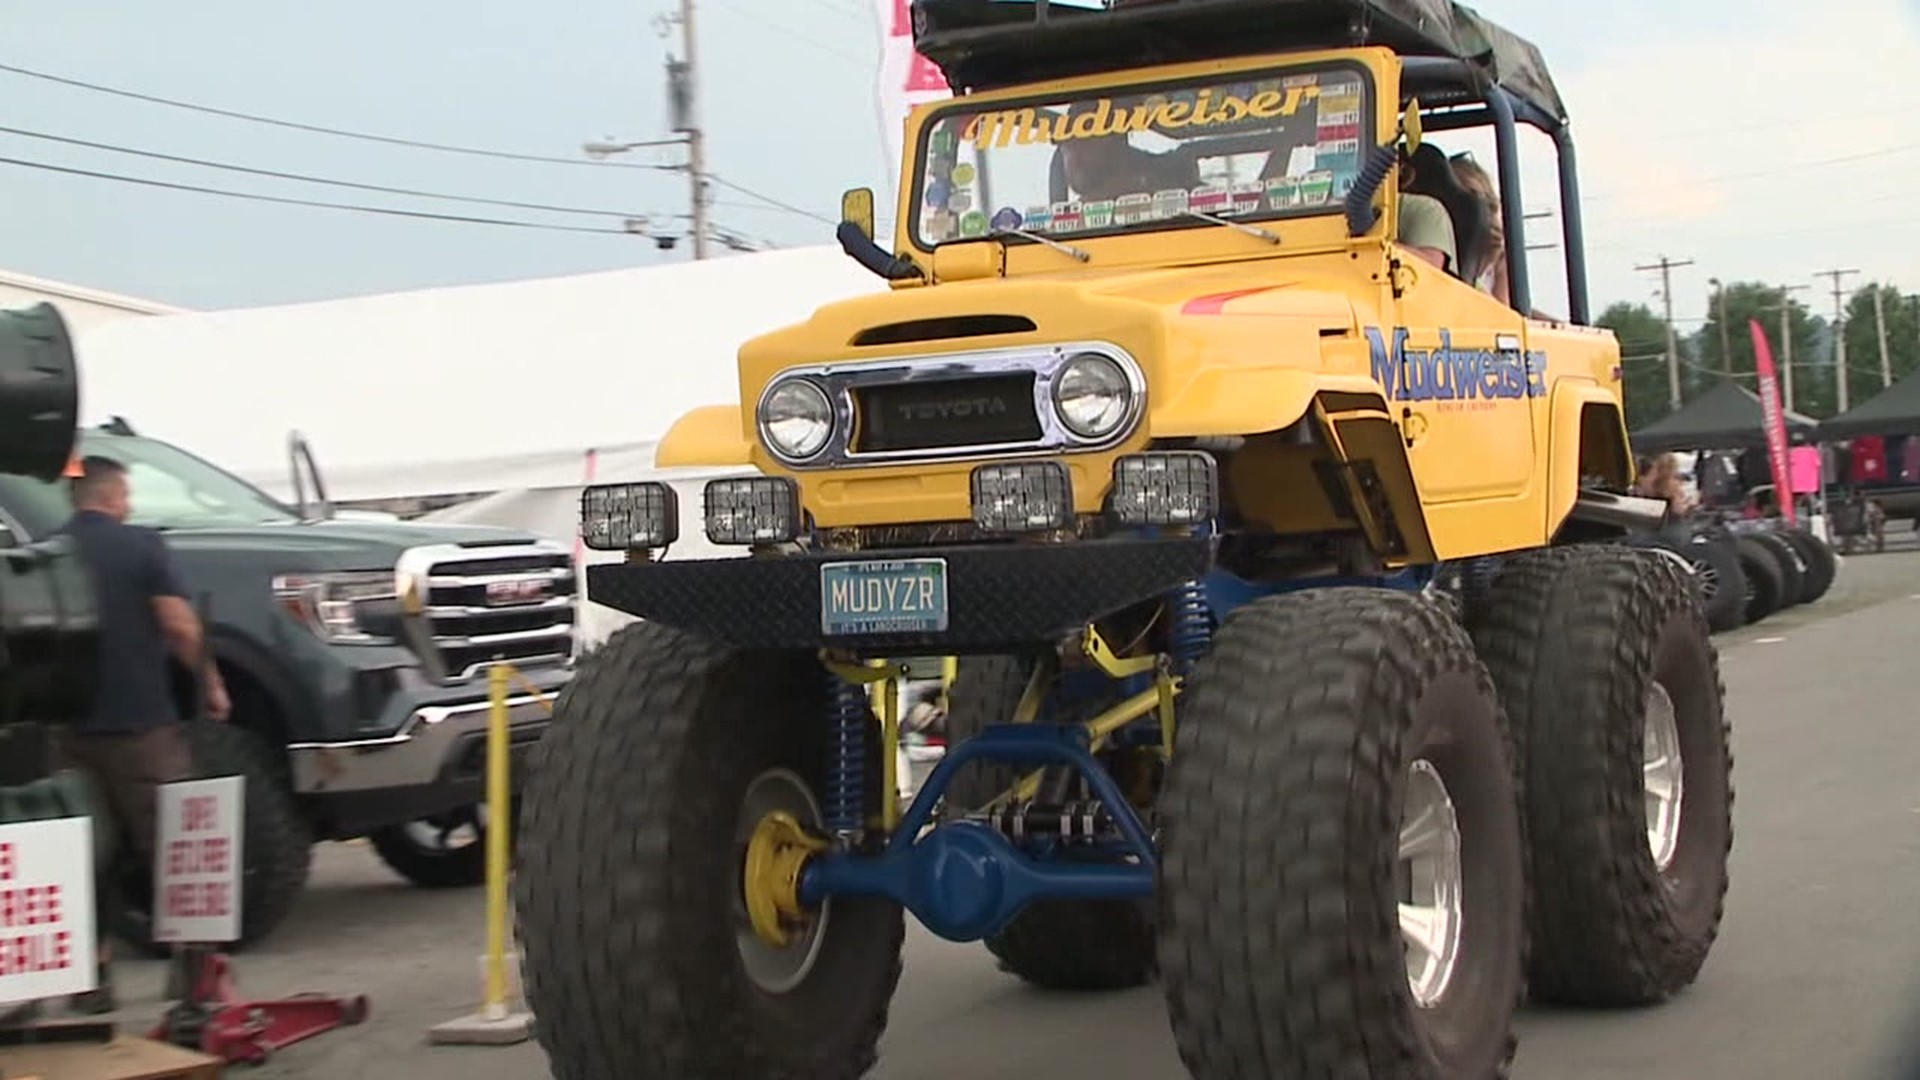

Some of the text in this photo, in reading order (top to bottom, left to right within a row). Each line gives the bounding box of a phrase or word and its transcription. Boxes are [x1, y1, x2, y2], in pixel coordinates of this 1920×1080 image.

[965, 86, 1321, 149] Mudweiser
[1364, 326, 1547, 401] Mudweiser
[900, 397, 1006, 419] TOYOTA
[832, 576, 934, 613] MUDYZR
